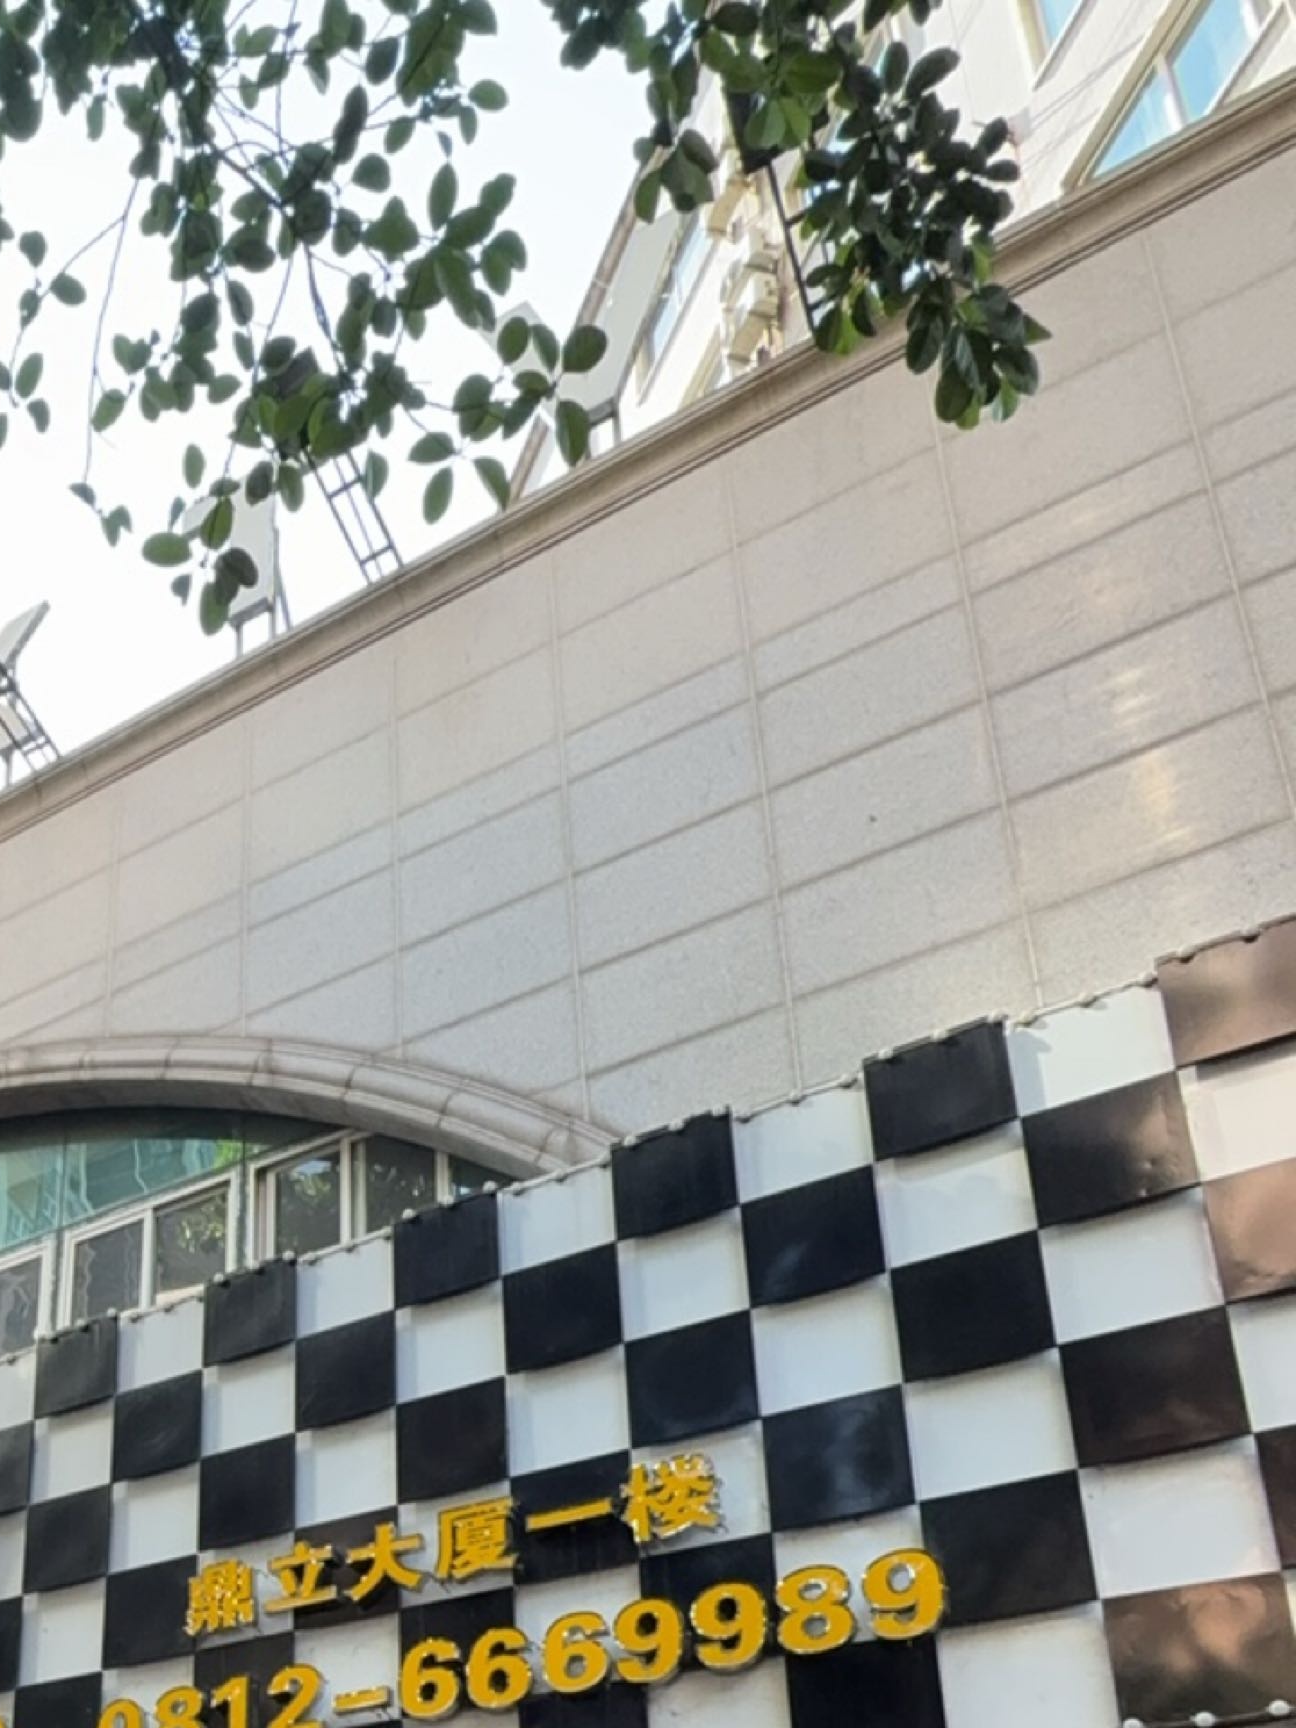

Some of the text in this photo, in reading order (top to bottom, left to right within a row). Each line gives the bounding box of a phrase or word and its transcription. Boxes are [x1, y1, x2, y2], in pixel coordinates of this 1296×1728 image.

[185, 1454, 720, 1636] 鼎立大厦一楼
